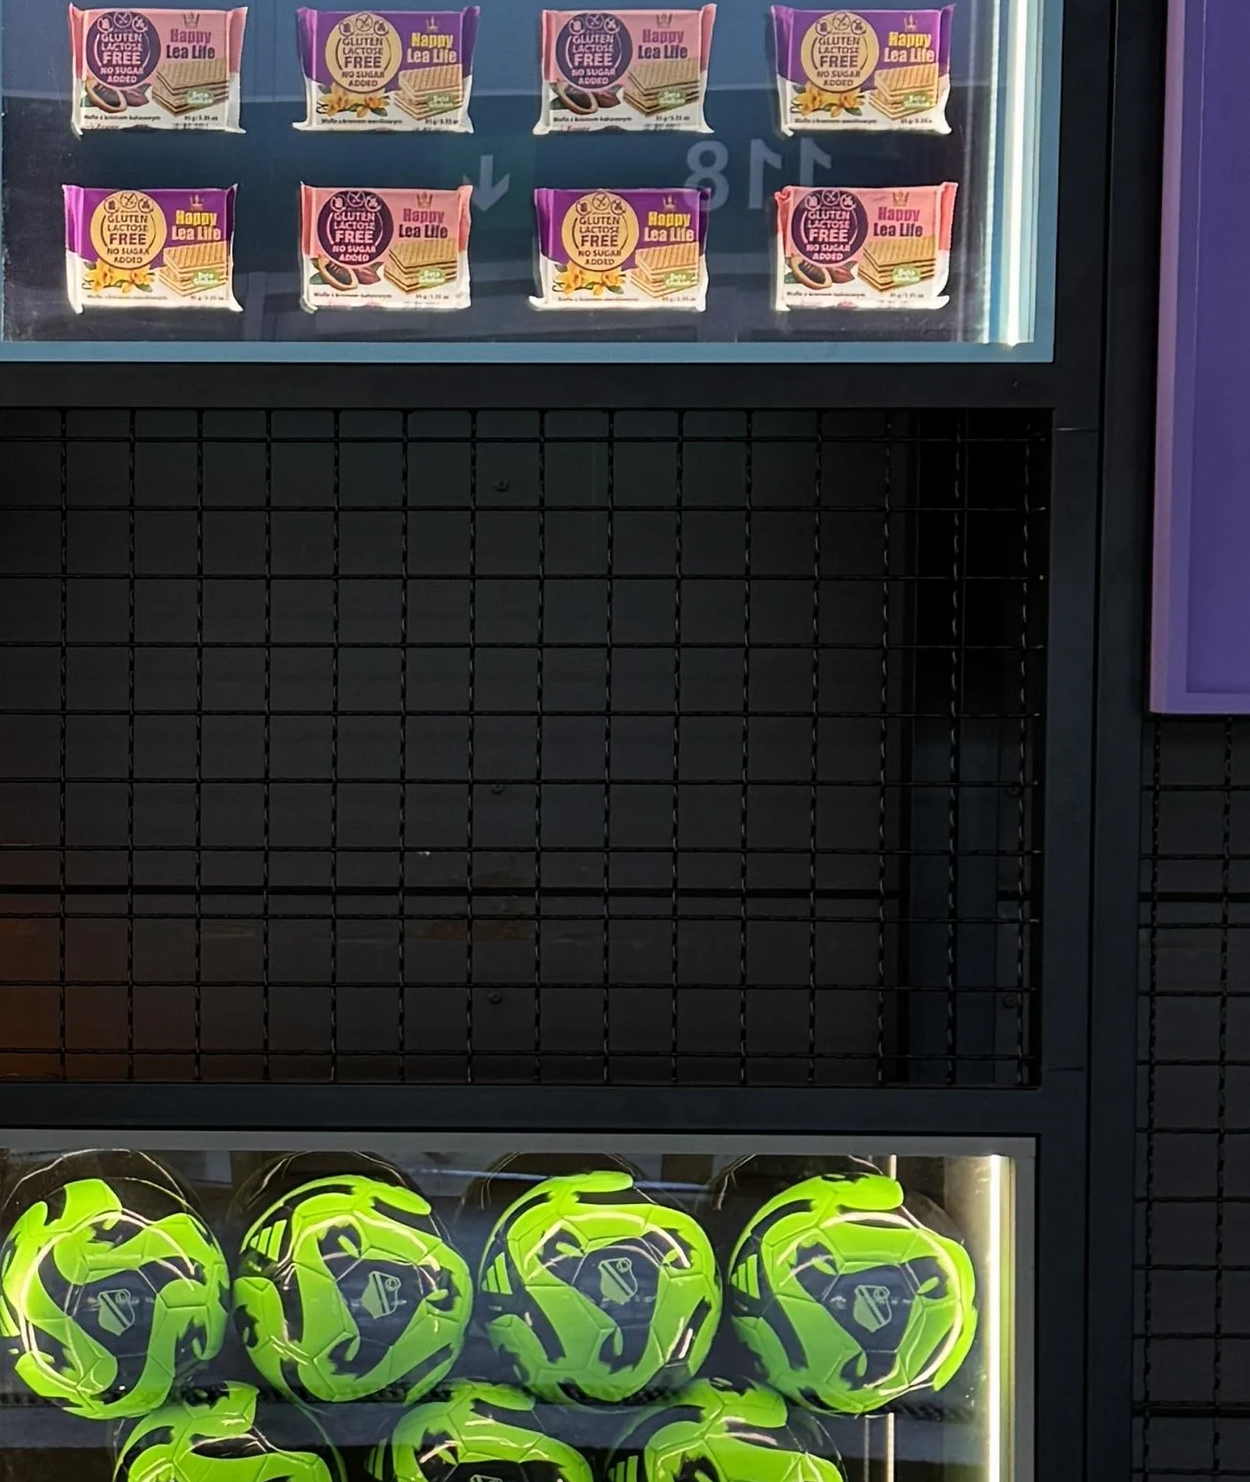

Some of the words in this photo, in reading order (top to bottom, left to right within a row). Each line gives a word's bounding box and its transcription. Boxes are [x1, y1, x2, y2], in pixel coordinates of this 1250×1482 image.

[412, 32, 453, 49] Happy
[889, 30, 931, 48] Happy
[103, 51, 141, 65] FREE
[345, 56, 382, 69] FREE
[407, 49, 431, 64] Lea
[433, 48, 457, 64] Life
[574, 53, 612, 67] FREE
[820, 56, 857, 68] FREE
[884, 47, 908, 63] Lea
[910, 47, 935, 63] Life
[176, 209, 217, 226] Happy
[648, 211, 690, 228] Happy
[110, 233, 147, 246] FREE
[171, 225, 195, 241] Lea
[197, 225, 221, 241] Life
[336, 230, 373, 243] FREE
[644, 227, 668, 243] Lea
[670, 227, 694, 243] Life
[809, 229, 847, 243] FREE
[582, 235, 619, 248] FREE
